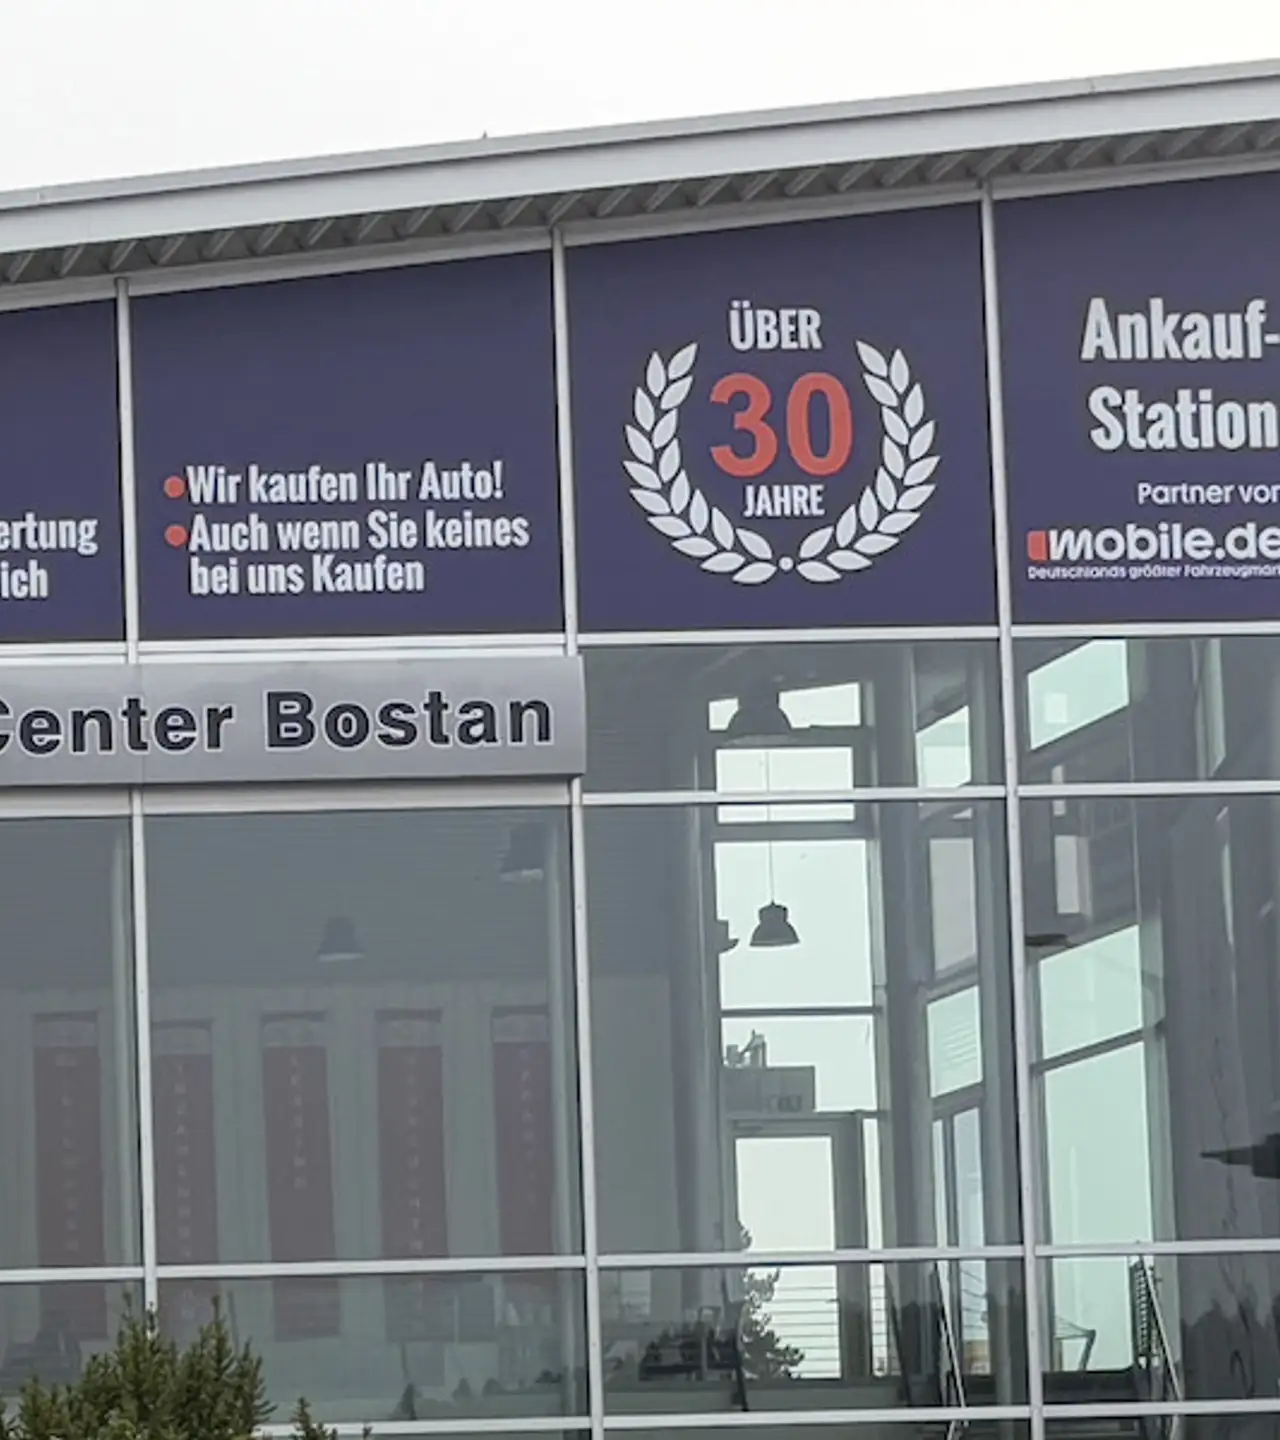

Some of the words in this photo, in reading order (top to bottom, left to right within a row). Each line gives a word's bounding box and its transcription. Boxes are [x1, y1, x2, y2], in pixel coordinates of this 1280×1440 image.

[730, 301, 822, 350] ÜBER
[1081, 297, 1280, 360] Ankauf-
[709, 372, 853, 477] 30
[1089, 386, 1278, 450] Station
[186, 464, 242, 504] Wir
[248, 464, 358, 503] kaufen
[366, 462, 412, 501] Ihr
[418, 460, 504, 501] Auto!
[744, 484, 825, 517] JAHRE
[1138, 483, 1235, 505] Partner
[189, 513, 269, 552] Auch
[277, 520, 360, 551] wenn
[368, 509, 418, 549] Sie
[426, 509, 530, 548] keines
[1049, 522, 1280, 561] mobile.de
[190, 556, 239, 595] bei
[247, 563, 305, 595] uns
[312, 554, 424, 592] Kaufen
[266, 690, 552, 749] Bostan
